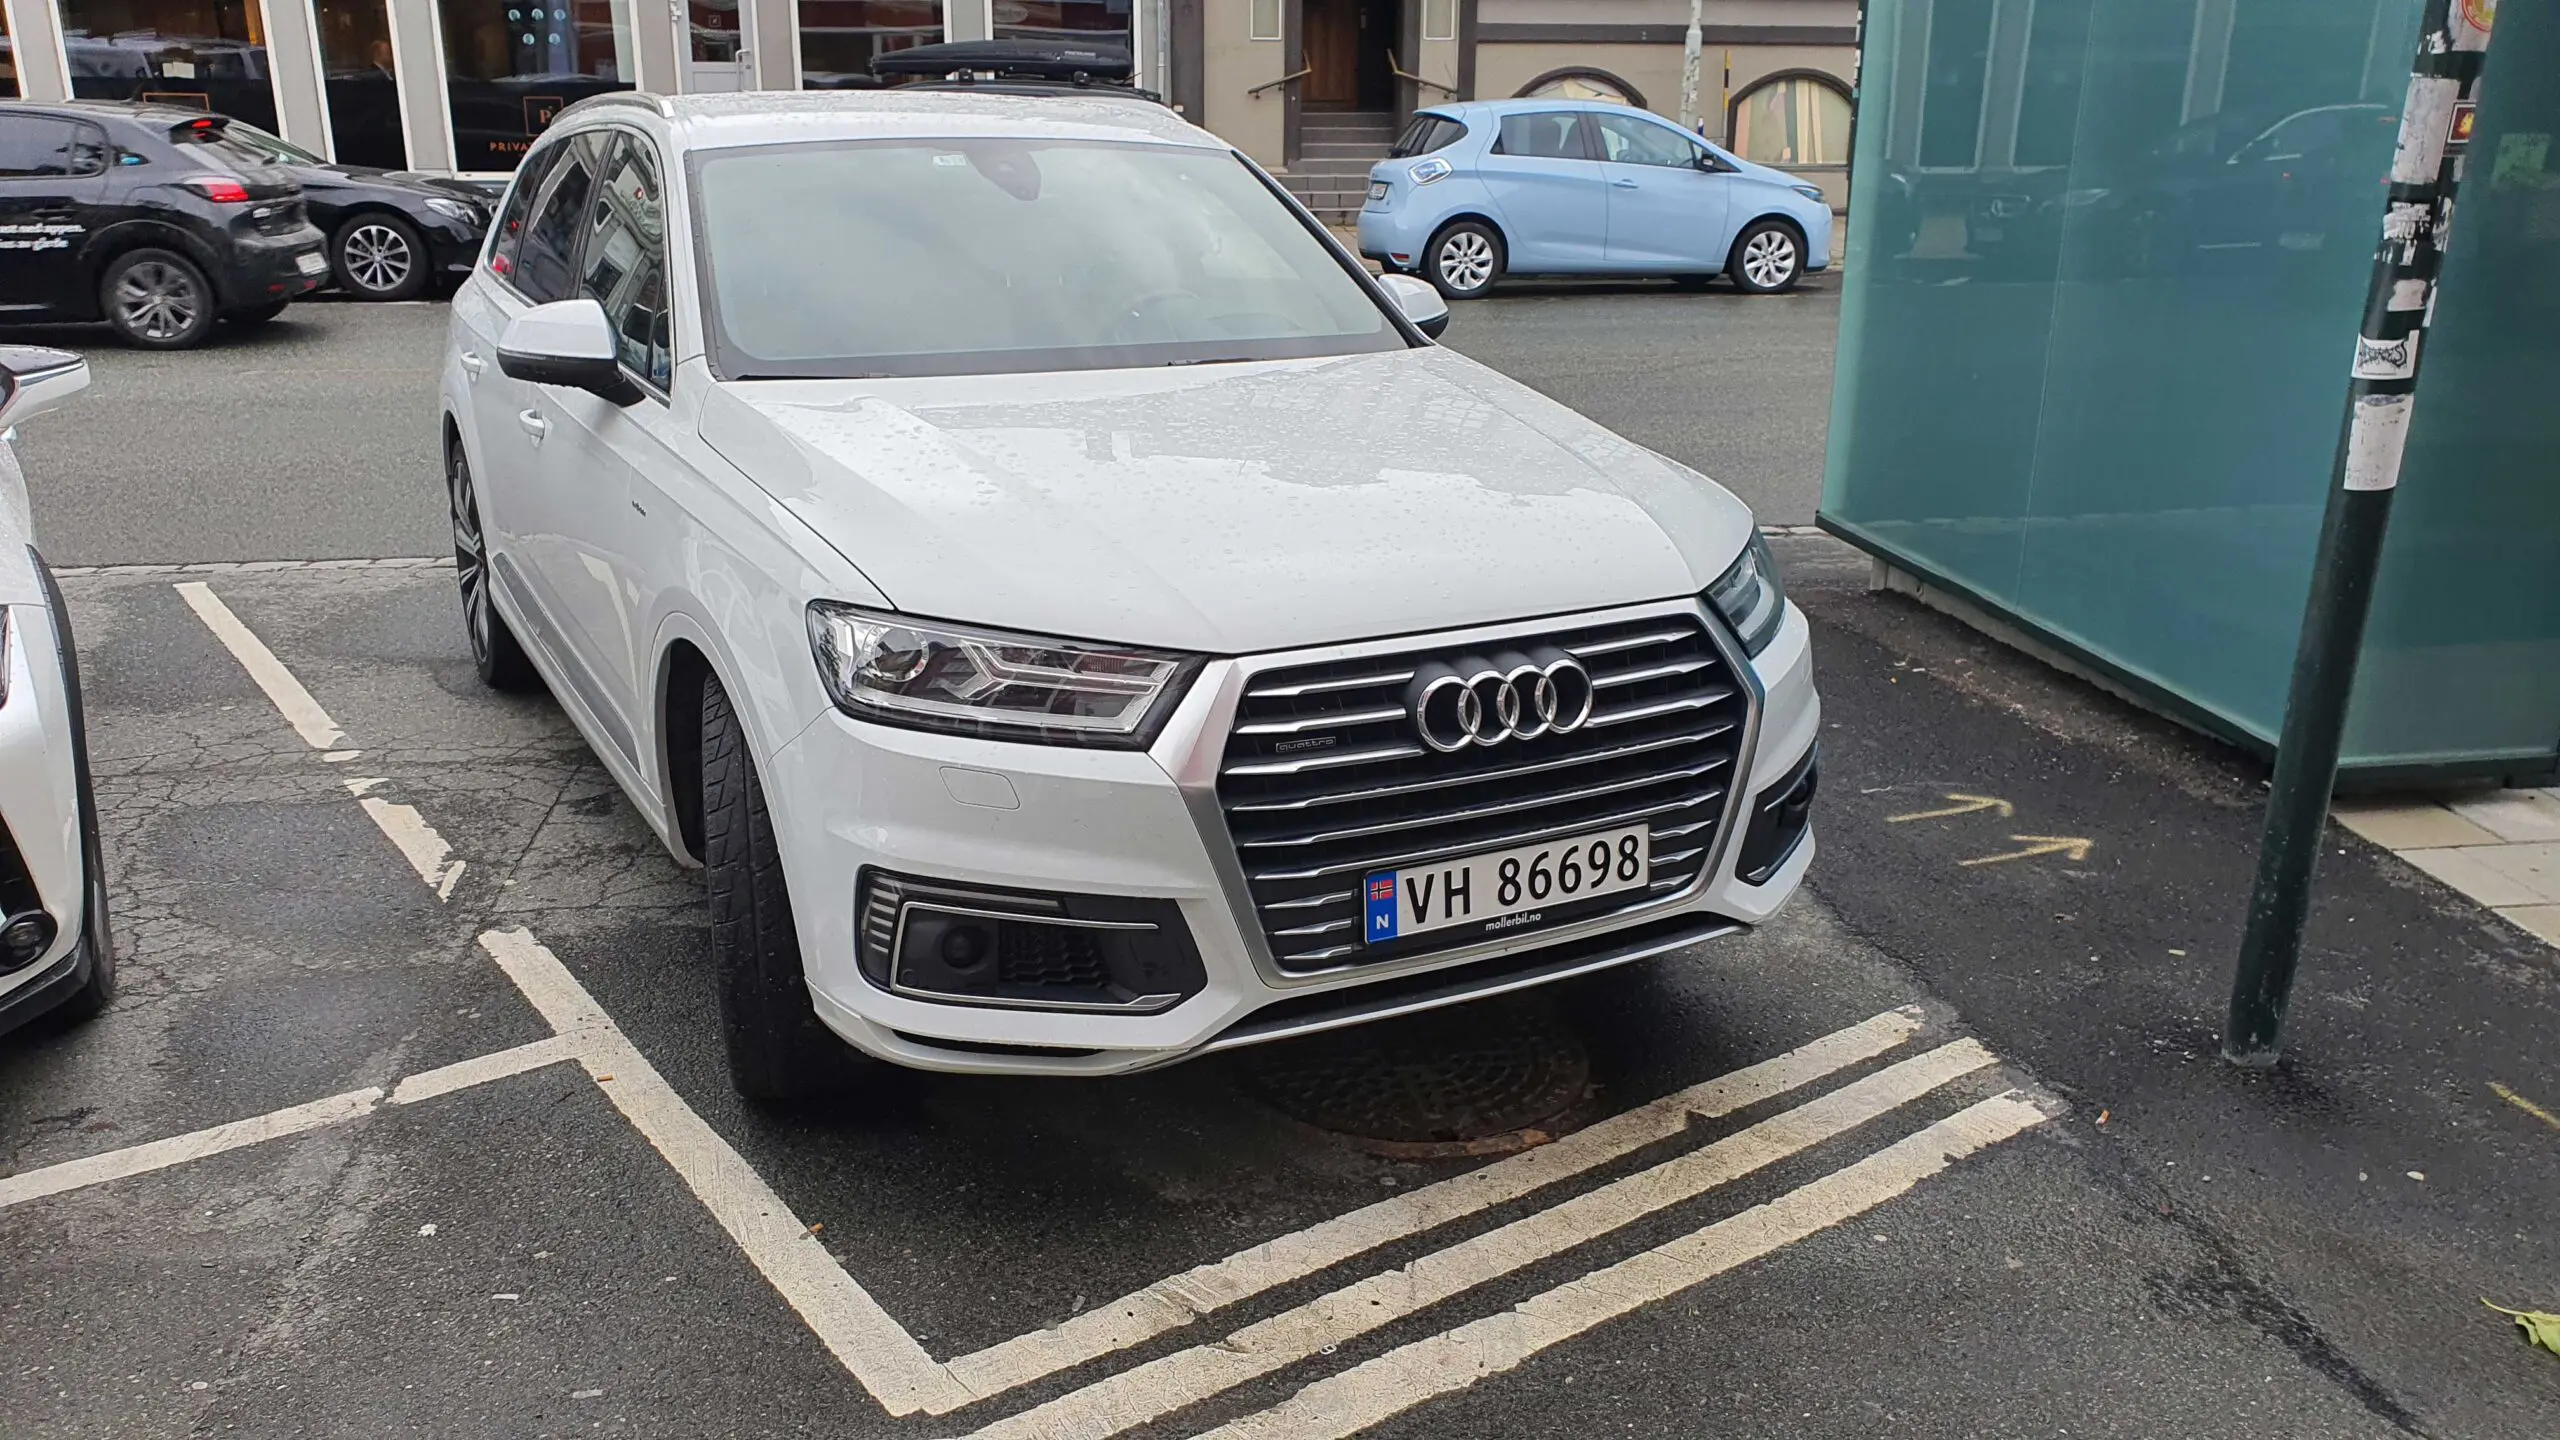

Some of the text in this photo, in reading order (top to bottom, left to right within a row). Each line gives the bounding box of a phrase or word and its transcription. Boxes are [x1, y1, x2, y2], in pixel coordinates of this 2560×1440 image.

[1279, 738, 1334, 753] quattro
[1405, 834, 1640, 925] VH 86698
[1376, 913, 1390, 930] N
[1485, 911, 1542, 932] mollerbil.no
